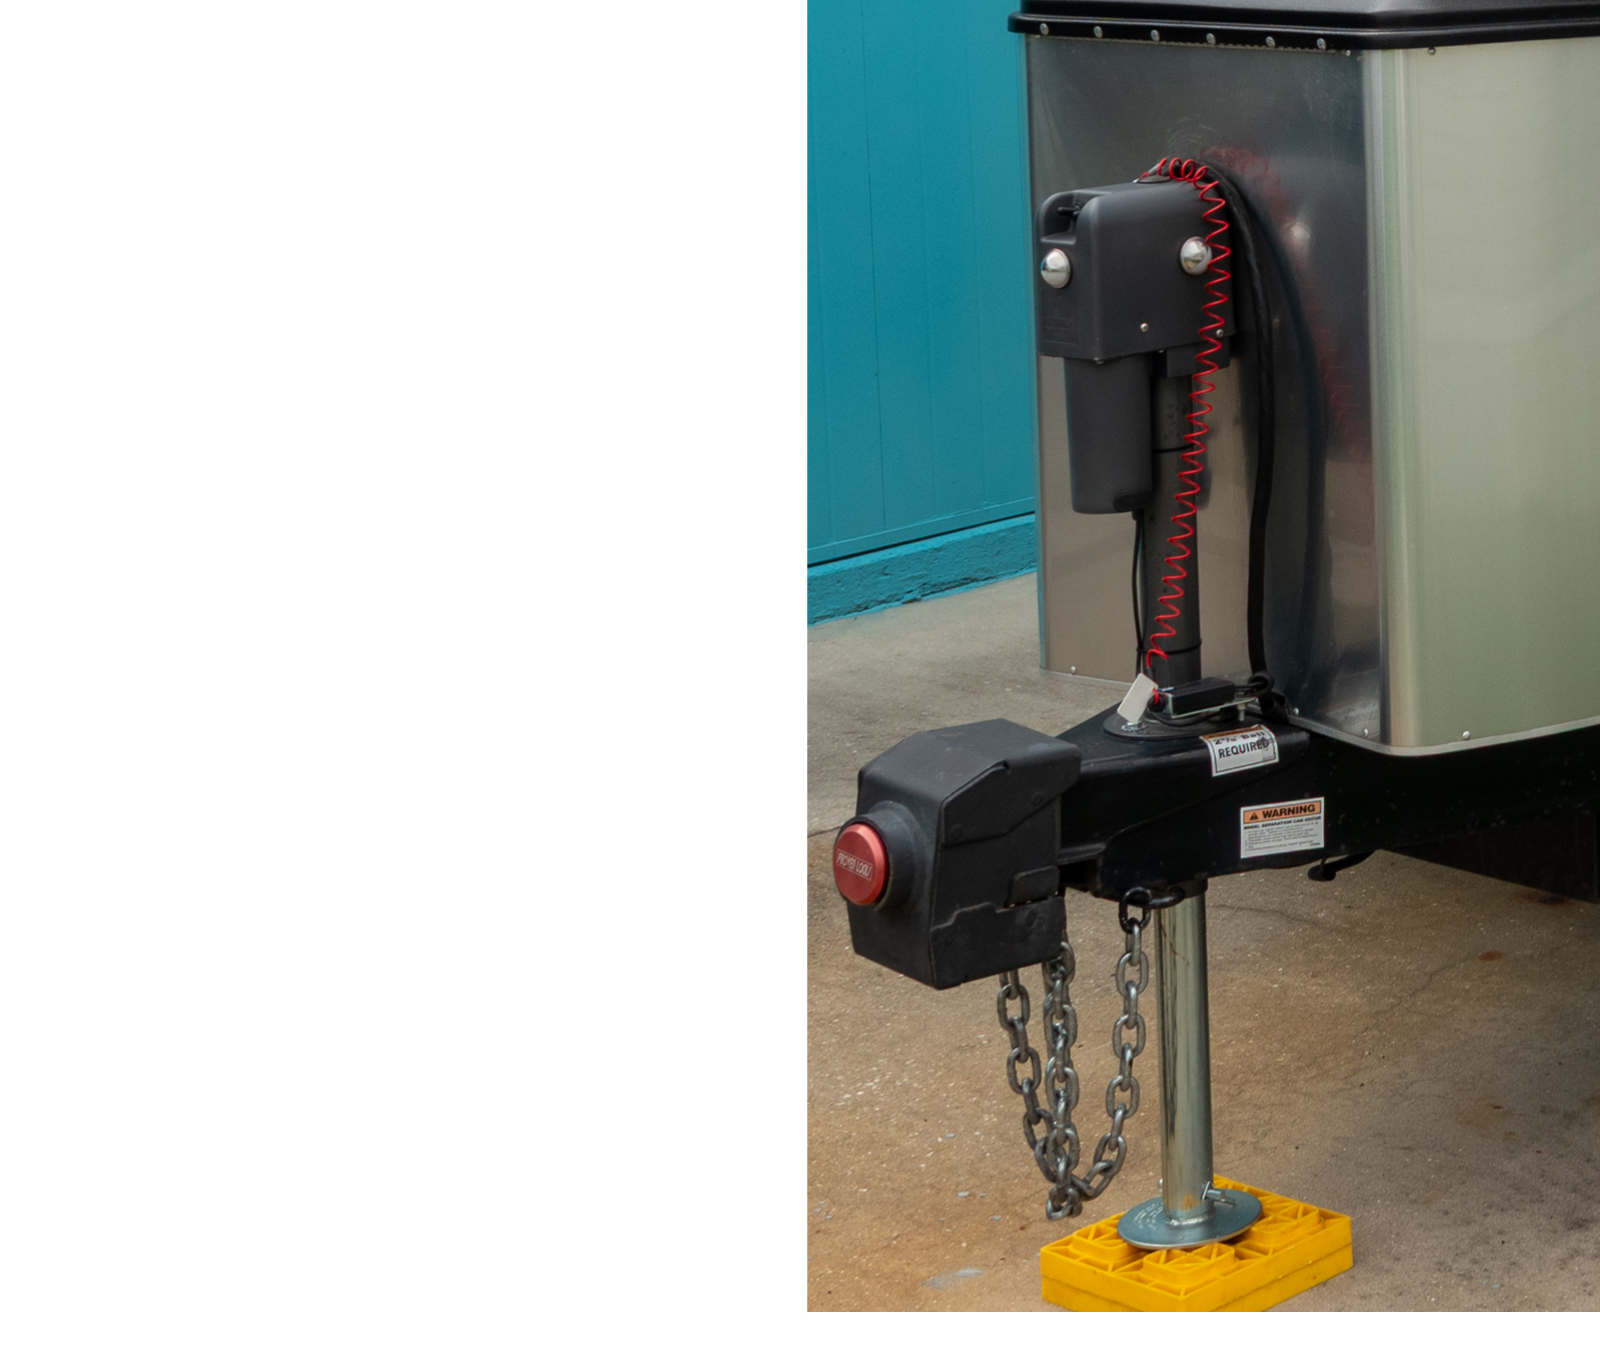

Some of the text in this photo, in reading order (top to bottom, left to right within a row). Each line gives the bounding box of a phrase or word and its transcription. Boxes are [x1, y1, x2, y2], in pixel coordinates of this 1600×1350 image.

[1218, 739, 1270, 759] REQUIRED
[1262, 803, 1316, 819] WARNING
[1262, 819, 1292, 828] SEPARATION
